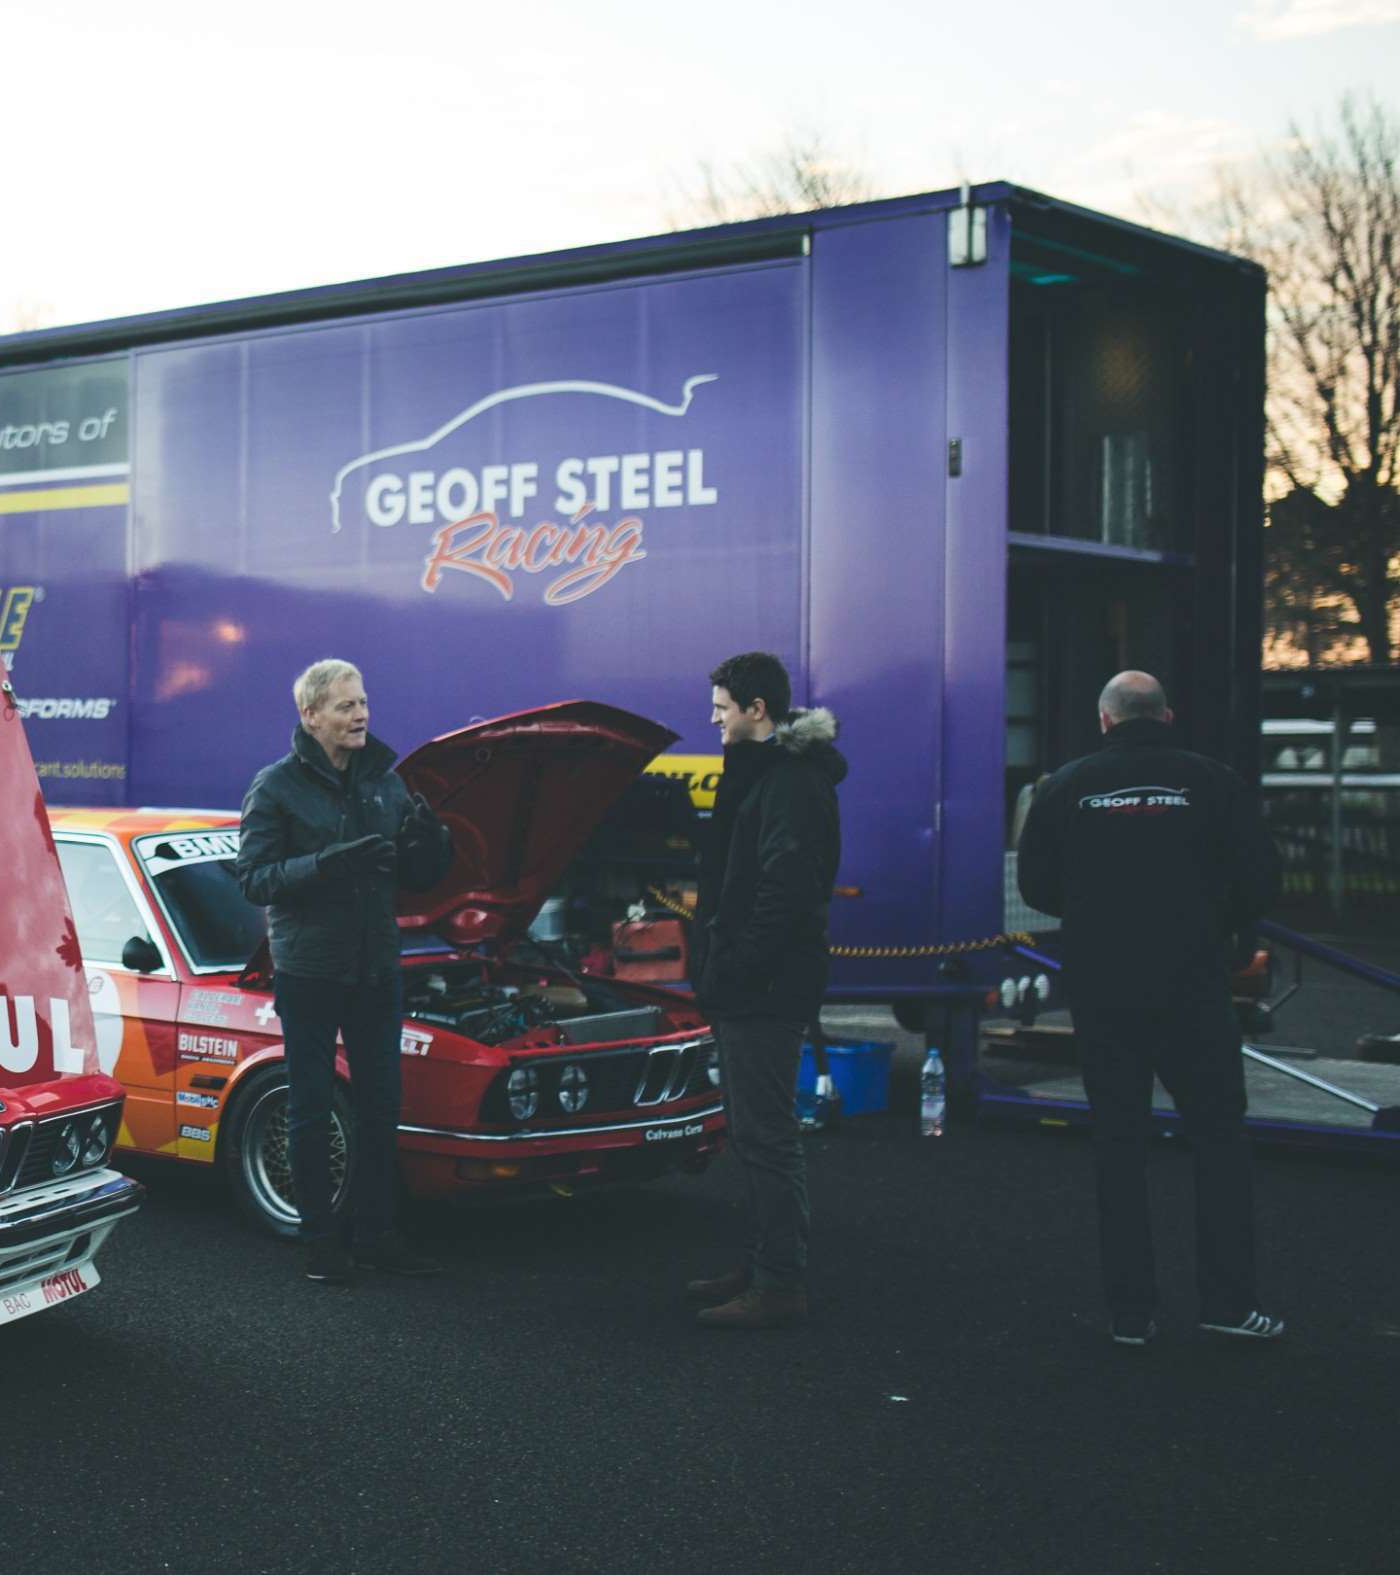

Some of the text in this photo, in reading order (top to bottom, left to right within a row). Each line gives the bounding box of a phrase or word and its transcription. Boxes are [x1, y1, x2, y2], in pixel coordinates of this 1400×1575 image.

[78, 408, 117, 441] of
[365, 448, 718, 527] GEOFF STEEL
[421, 501, 647, 606] Racing
[1090, 796, 1190, 808] GEOFF STEEL
[178, 1033, 238, 1057] BILSTEIN
[4, 1293, 31, 1316] BAC
[40, 1268, 87, 1304] MOTUL
